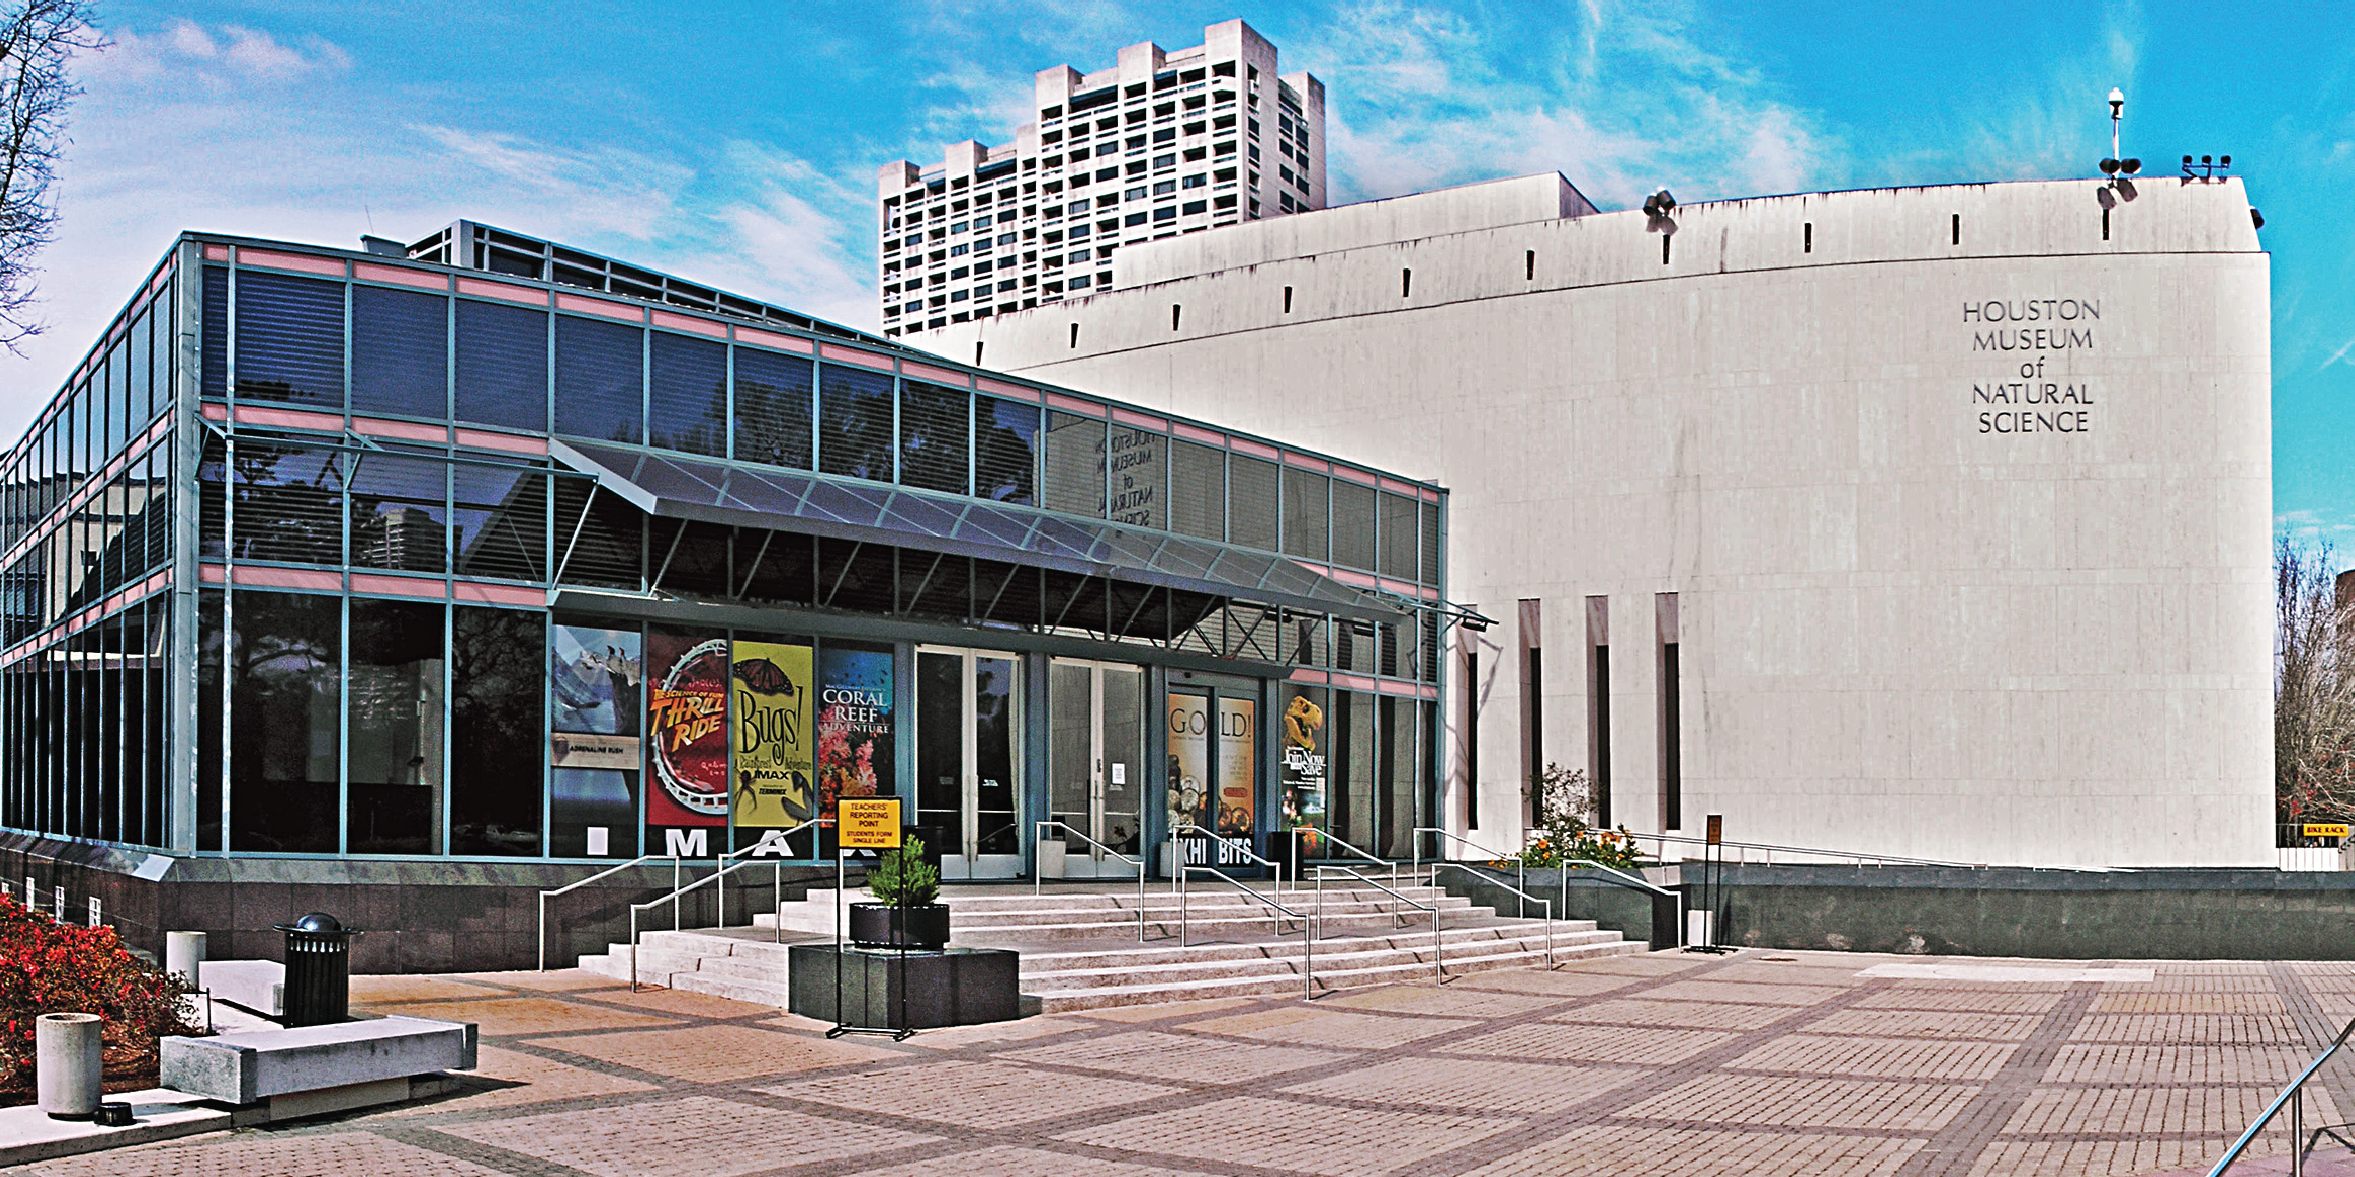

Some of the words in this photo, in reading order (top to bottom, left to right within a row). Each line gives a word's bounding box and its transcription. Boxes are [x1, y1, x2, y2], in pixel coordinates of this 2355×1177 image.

[1963, 299, 2100, 322] HOUSTON
[1973, 328, 2093, 351] MUSEUM
[2020, 355, 2045, 378] of
[1973, 383, 2094, 405] NATURAL
[1979, 411, 2089, 433] SCIENCE
[665, 690, 698, 698] SCIENCE
[823, 689, 887, 706] CORAL
[650, 697, 724, 736] THRILL
[835, 705, 878, 722] REEF
[672, 713, 722, 752] RIDE
[737, 686, 803, 766] Bugs!
[822, 723, 889, 733] ADVENTURE
[570, 745, 607, 754] ADRENALINE
[1285, 749, 1303, 765] Join
[1303, 750, 1325, 766] Now
[754, 770, 789, 780] IMAX
[1301, 764, 1322, 776] Save
